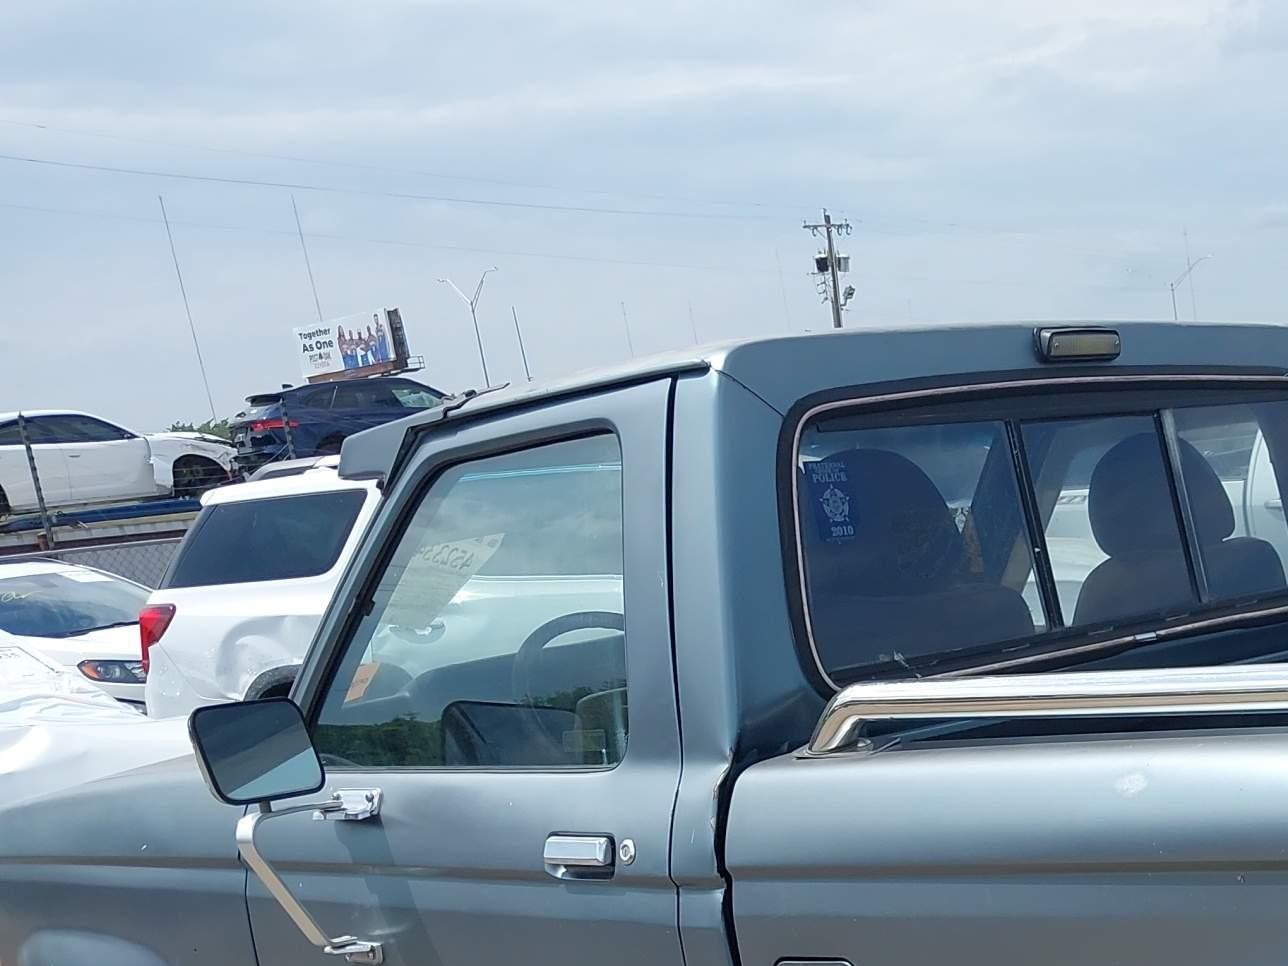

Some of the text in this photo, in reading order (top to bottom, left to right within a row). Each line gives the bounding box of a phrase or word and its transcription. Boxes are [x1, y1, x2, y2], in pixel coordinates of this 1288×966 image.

[298, 327, 331, 341] Together
[302, 339, 334, 353] As One
[812, 471, 848, 483] POLICE
